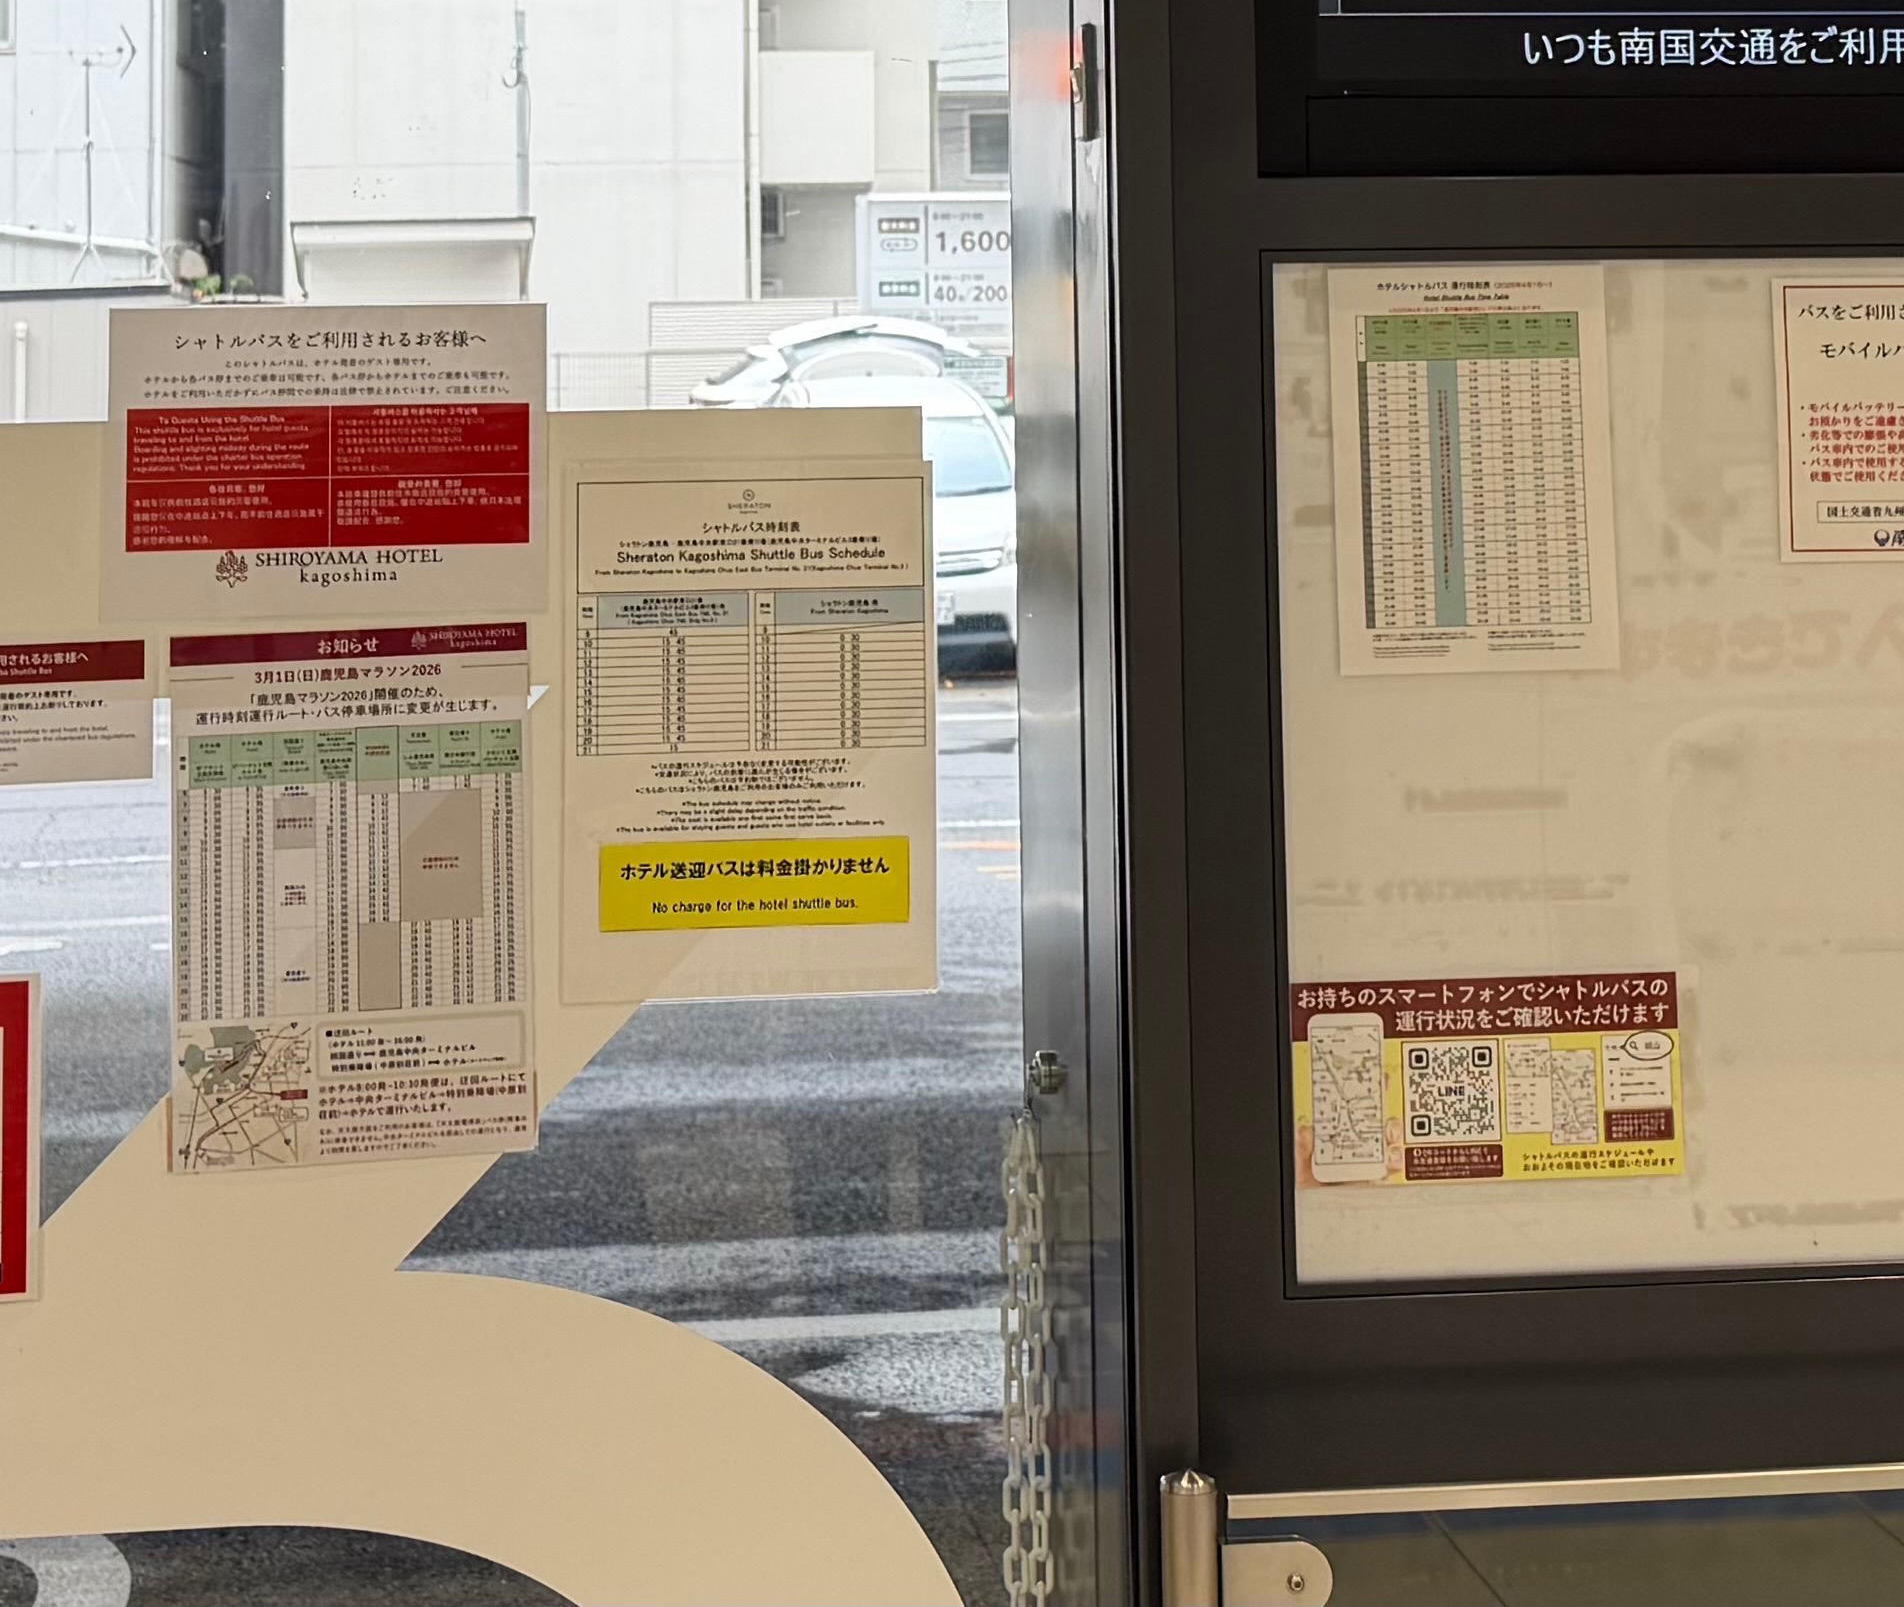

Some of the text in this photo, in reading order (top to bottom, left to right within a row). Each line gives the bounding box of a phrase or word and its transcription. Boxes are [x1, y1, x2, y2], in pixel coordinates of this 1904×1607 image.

[935, 230, 1011, 254] 1,600
[174, 329, 487, 351] シャトルバスをご利用されるお客様へ
[702, 521, 801, 534] シャトルバス時刻表
[254, 548, 444, 568] SHIROYAMA HOTEL
[616, 546, 885, 564] Sheraton Kagoshima Shuttle Bus Schedule
[299, 568, 398, 587] kagoshima
[317, 637, 381, 655] お知らせ
[619, 857, 891, 882] ホテル送迎バスは料金掛かりません
[652, 897, 859, 915] No charge for the hotel shuttle bus.
[1296, 977, 1670, 1010] お持ちのスマートフォンでシャトルバスの
[1395, 1002, 1670, 1032] 運行状況をご確認いただけます
[1437, 1085, 1466, 1098] LINE
